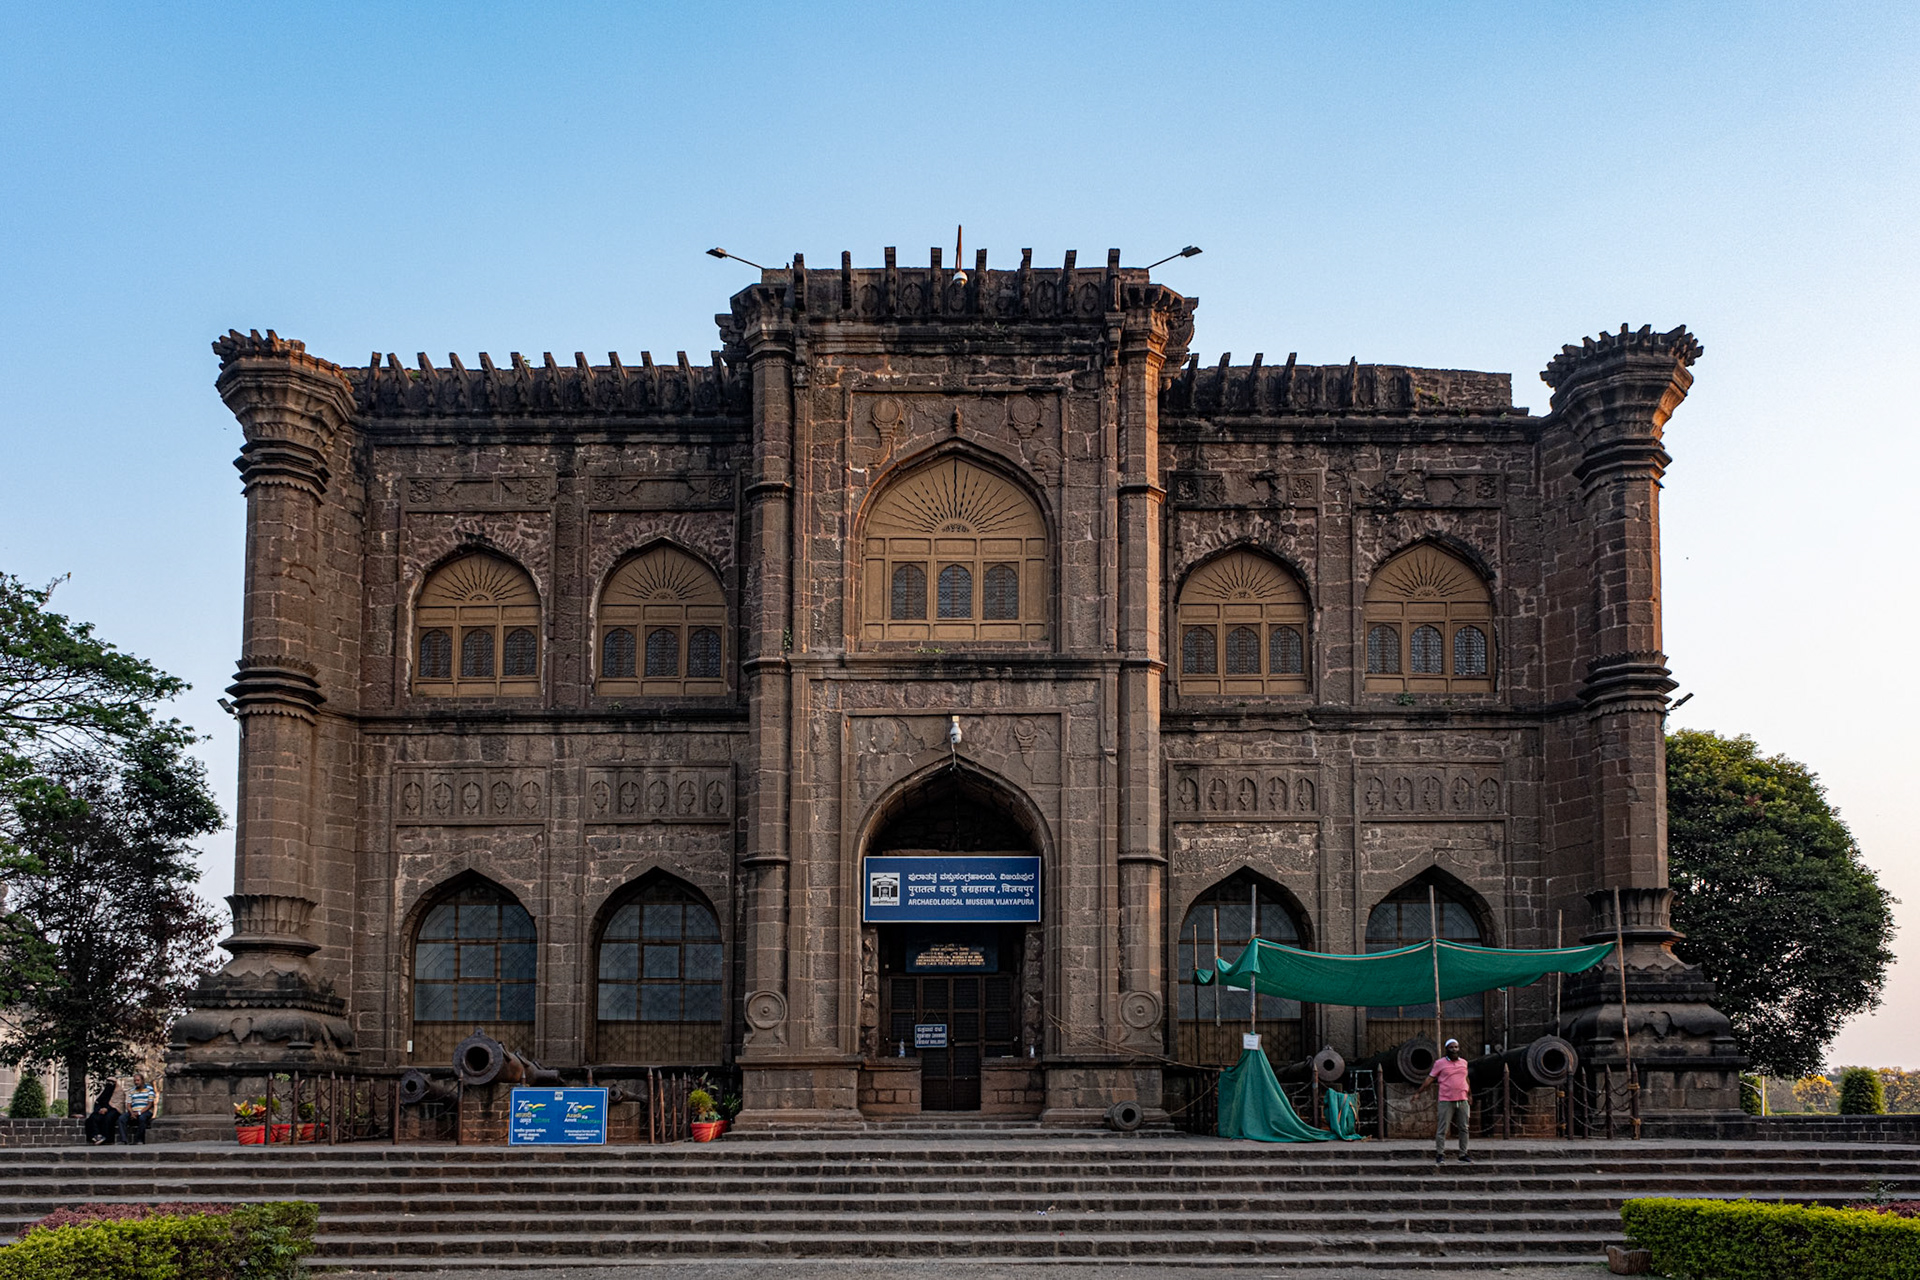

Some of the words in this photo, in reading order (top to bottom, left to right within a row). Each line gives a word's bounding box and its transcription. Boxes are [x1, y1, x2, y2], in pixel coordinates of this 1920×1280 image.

[908, 885, 936, 896] पुरातत्व
[939, 885, 957, 896] वस्तु
[1001, 883, 1034, 897] विजयपुर
